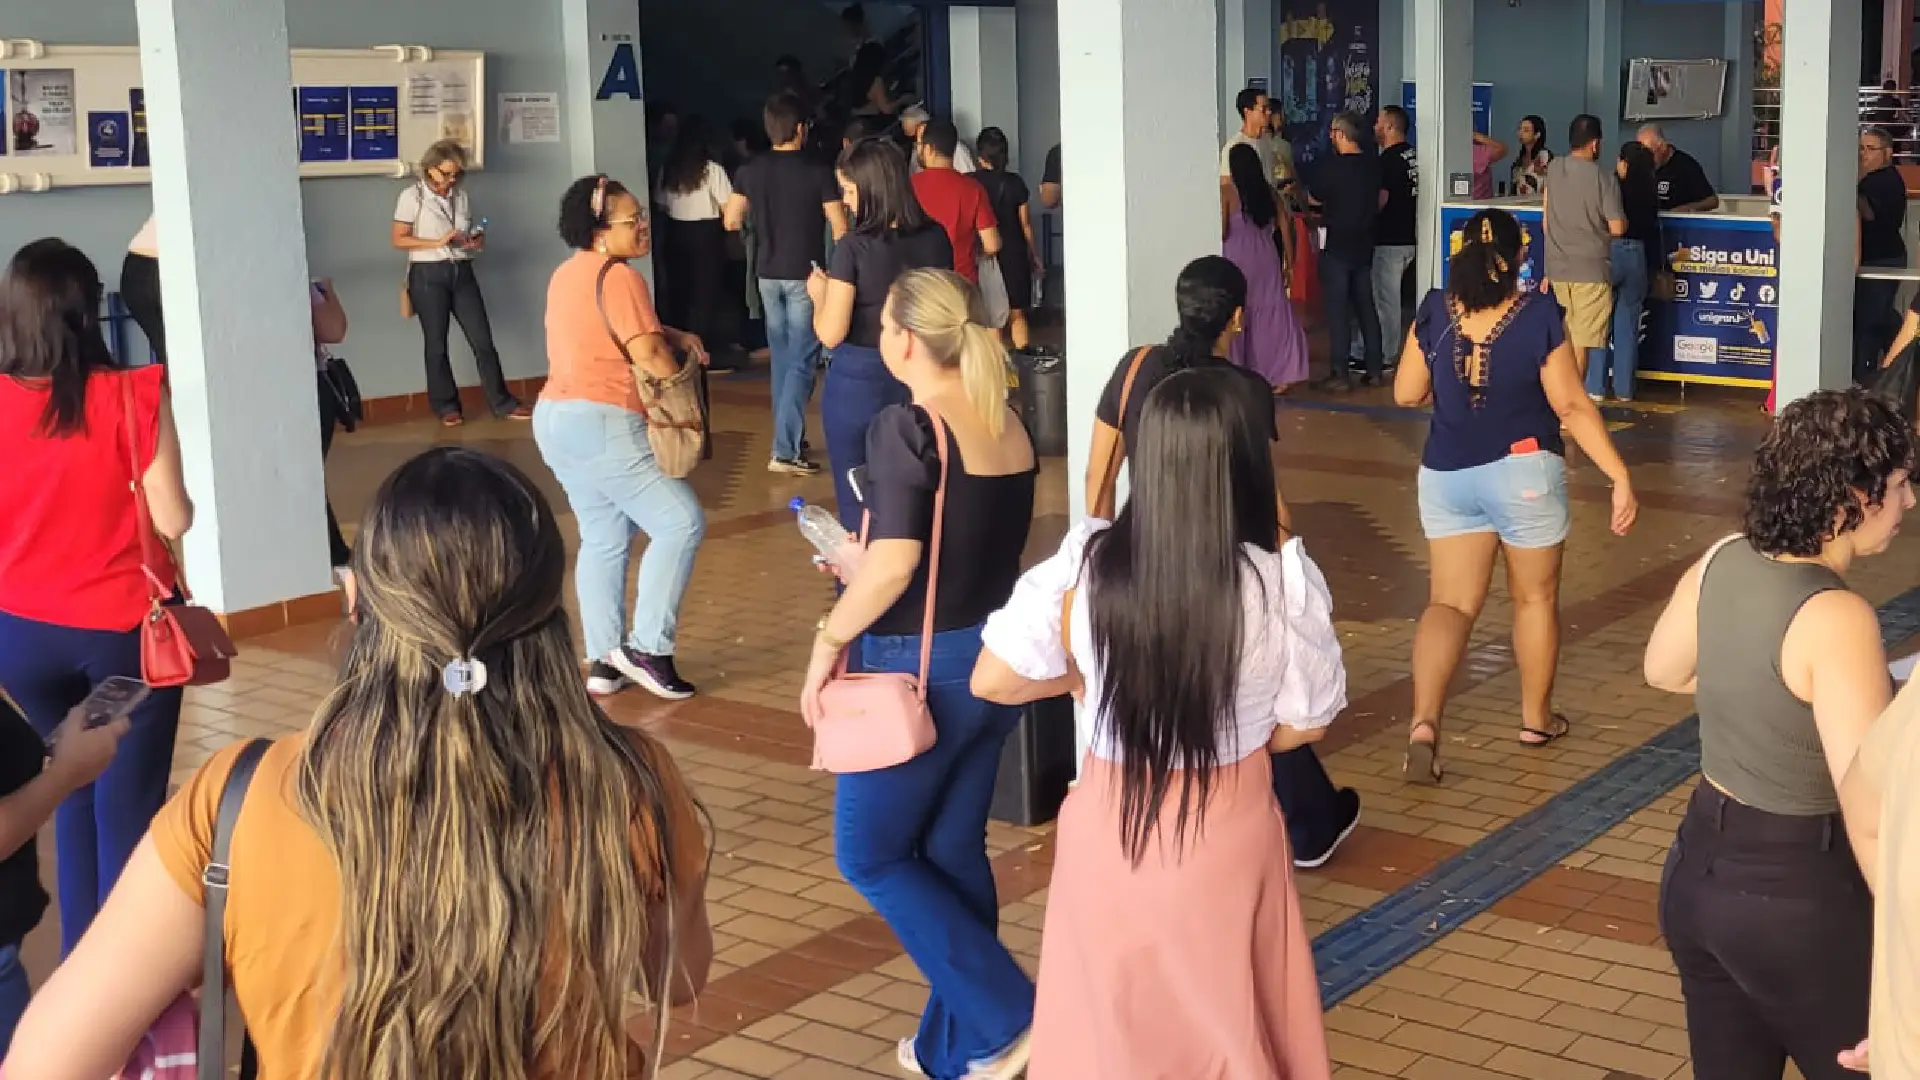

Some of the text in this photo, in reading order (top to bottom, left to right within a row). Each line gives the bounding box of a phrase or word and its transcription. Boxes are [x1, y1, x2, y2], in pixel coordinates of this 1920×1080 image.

[596, 43, 641, 100] A
[1690, 245, 1775, 266] Siga a Uni
